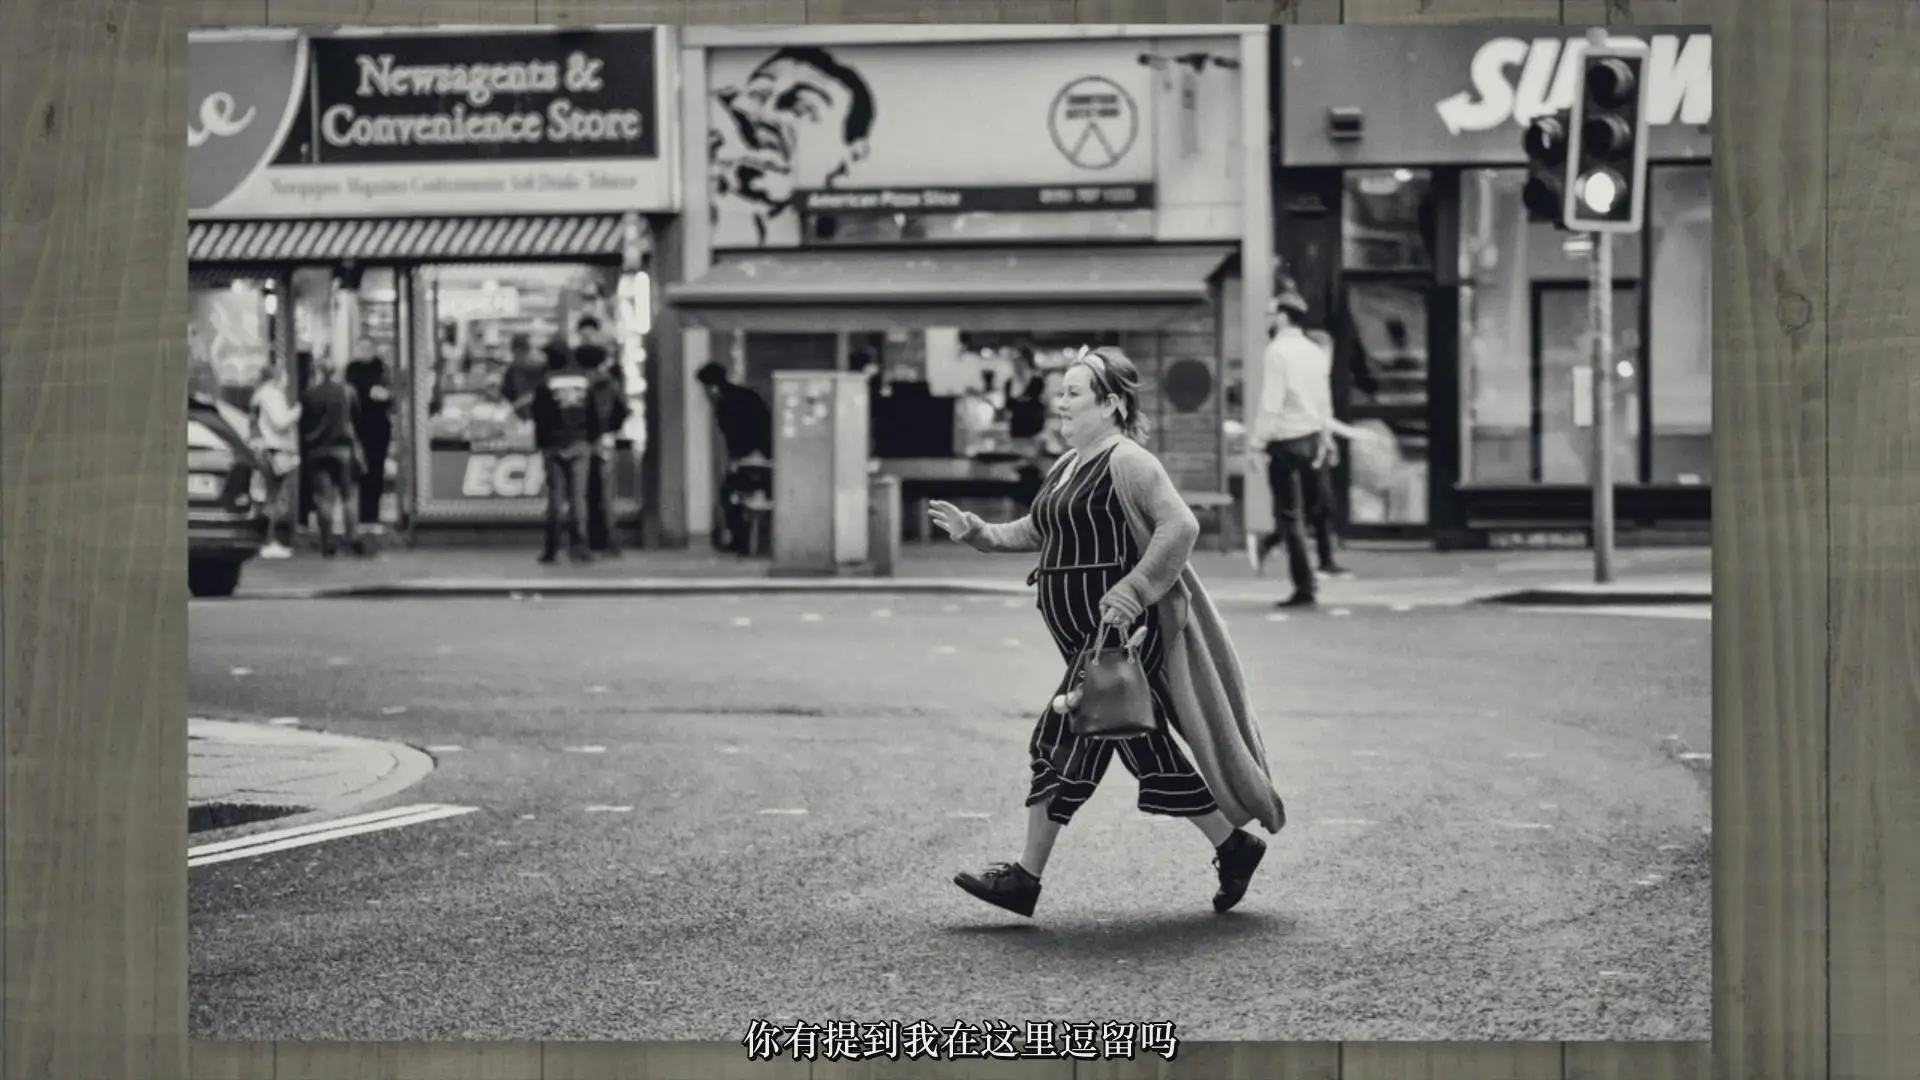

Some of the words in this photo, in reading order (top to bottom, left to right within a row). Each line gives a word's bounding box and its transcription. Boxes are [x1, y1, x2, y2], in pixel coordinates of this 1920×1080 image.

[355, 53, 560, 104] Newsagents
[564, 50, 604, 91] &
[321, 104, 542, 147] Convenience
[546, 99, 643, 141] Store
